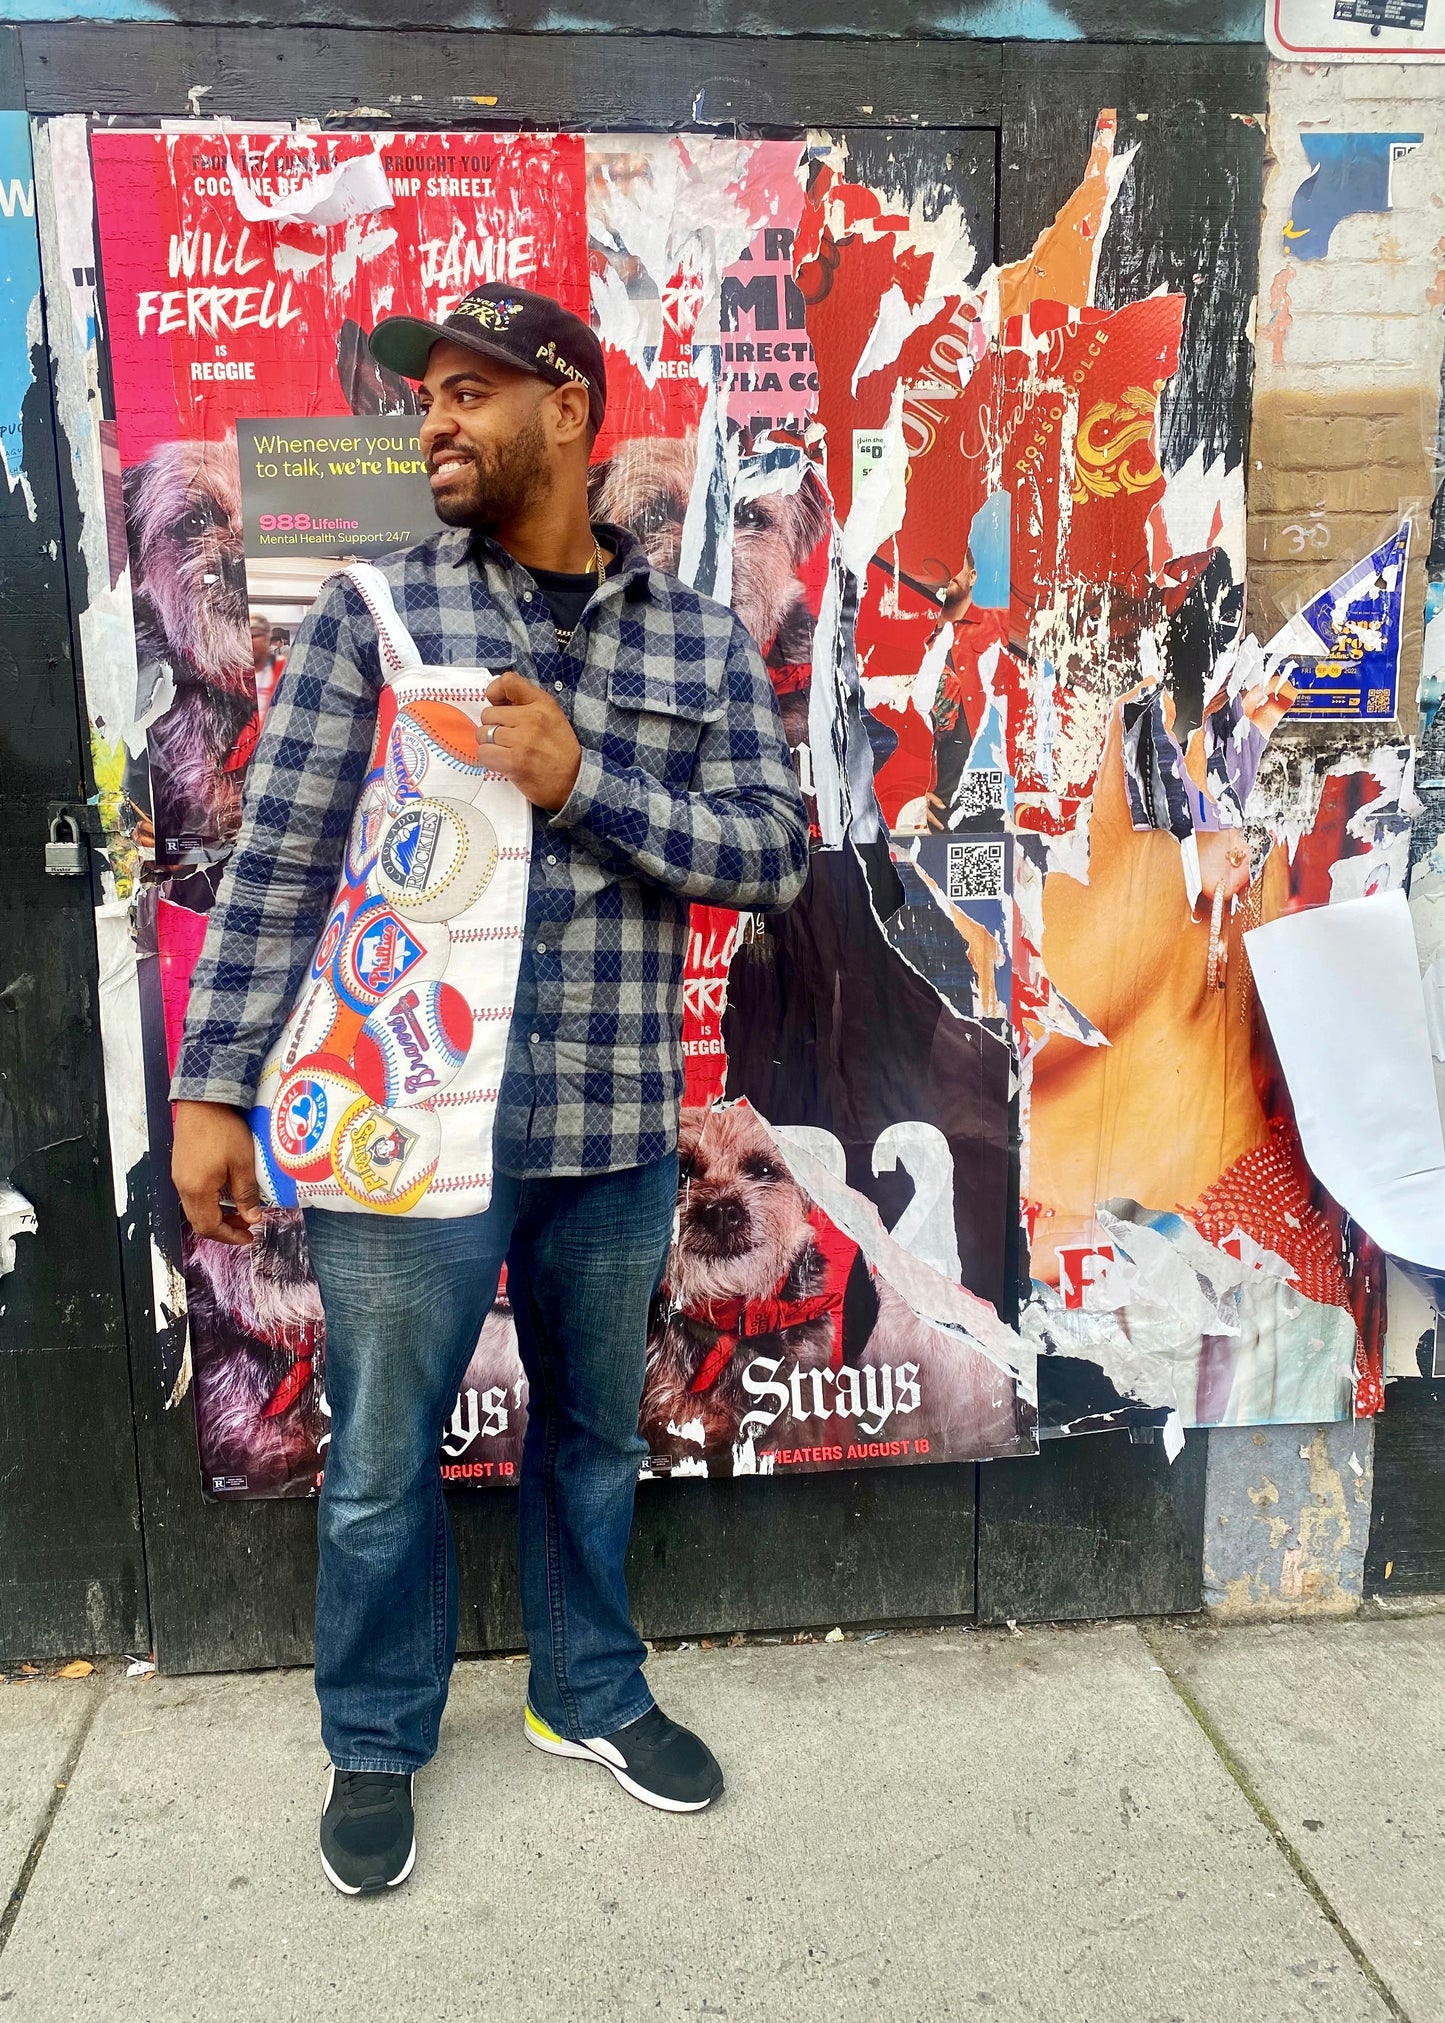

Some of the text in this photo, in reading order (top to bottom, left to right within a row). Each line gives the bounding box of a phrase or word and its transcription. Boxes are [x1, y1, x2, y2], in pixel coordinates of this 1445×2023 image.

[385, 156, 491, 172] BROUGHT YOU
[427, 177, 493, 197] STREET
[169, 227, 266, 281] WILL
[418, 234, 537, 289] JAMIE
[136, 280, 302, 340] FERRELL
[215, 345, 227, 357] IS
[191, 362, 256, 381] REGGIE
[253, 435, 361, 453] Whenever
[365, 437, 403, 455] you
[1016, 406, 1062, 473] ROSSO
[256, 461, 278, 478] to
[283, 458, 325, 479] talk,
[328, 458, 383, 476] we're
[259, 513, 359, 531] 988 Lifeline
[260, 531, 410, 545] Mental Health Support 24/7
[406, 811, 439, 890] ROCKIES
[369, 923, 399, 989] Phillies
[701, 1026, 711, 1035] IS
[278, 1087, 299, 1150] MONTREAL
[312, 1093, 326, 1140] EXPOS
[739, 1356, 922, 1434] Strays
[847, 1441, 909, 1459] AUGUST
[914, 1439, 930, 1454] 18
[498, 1461, 514, 1476] 18
